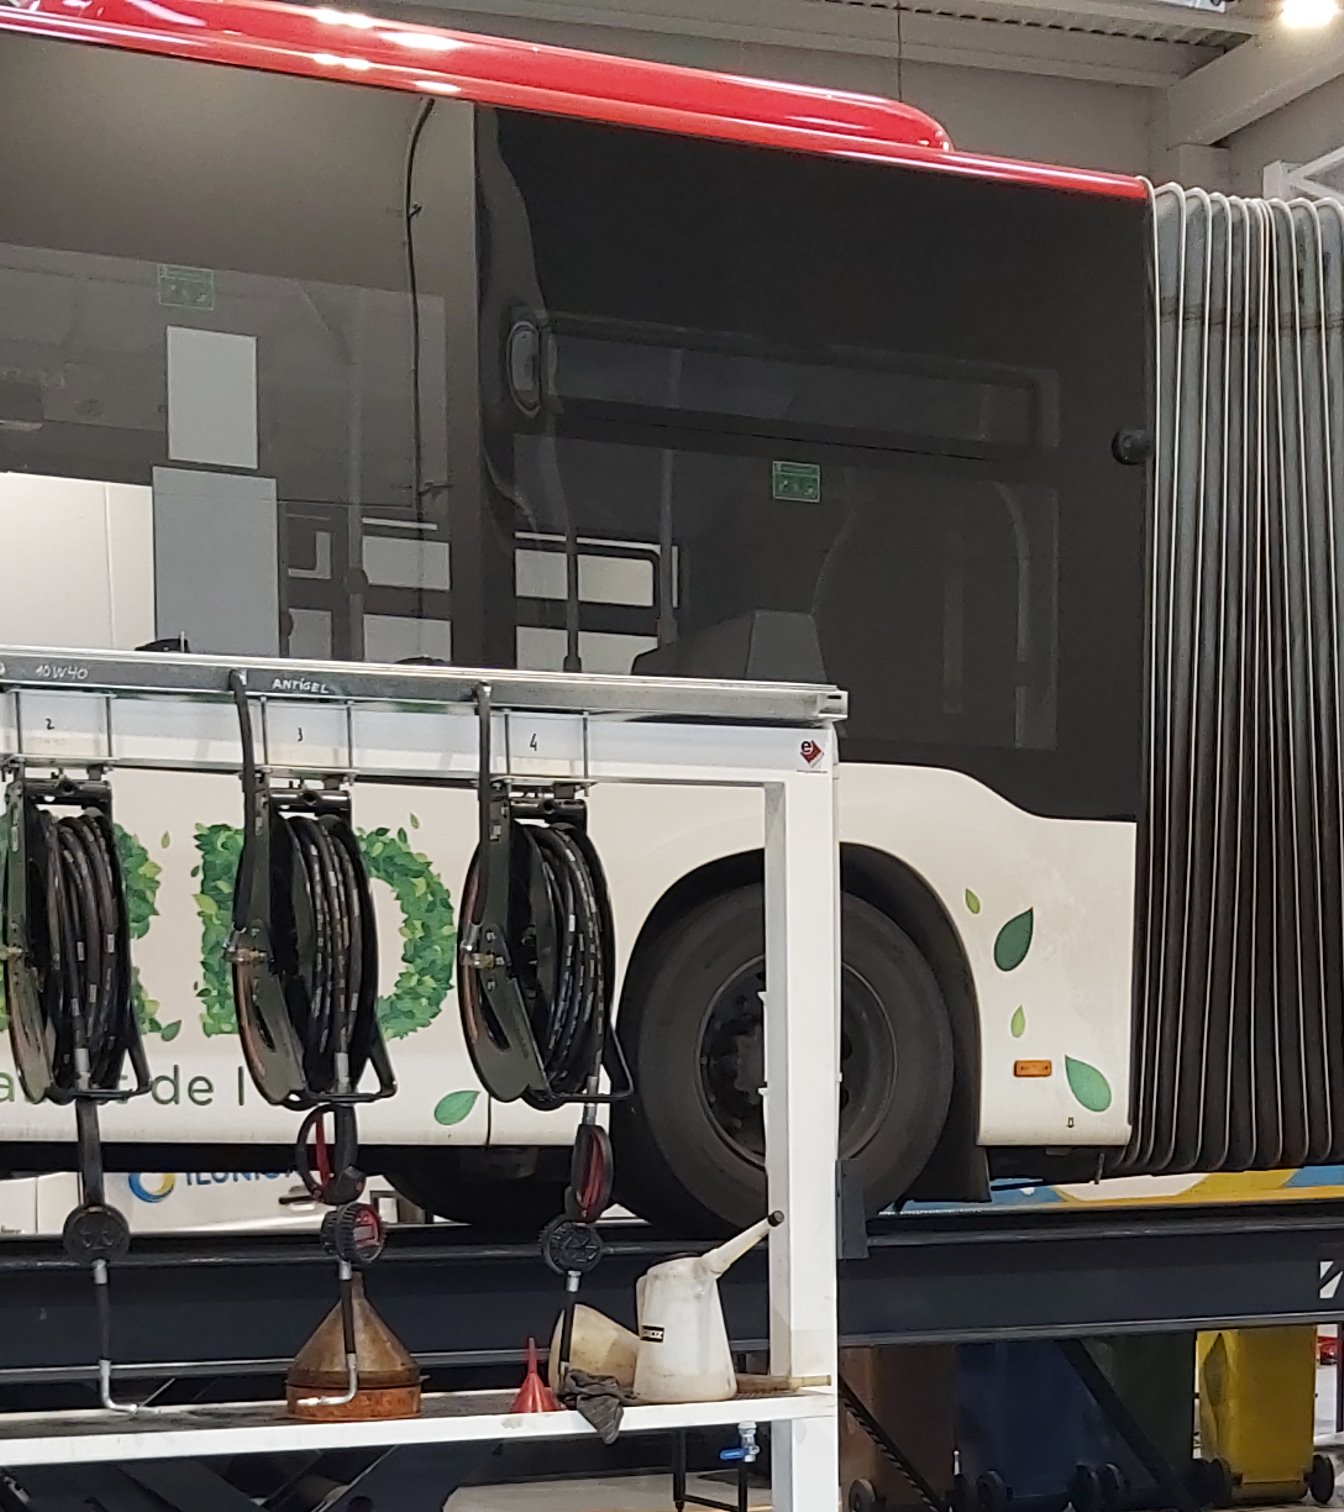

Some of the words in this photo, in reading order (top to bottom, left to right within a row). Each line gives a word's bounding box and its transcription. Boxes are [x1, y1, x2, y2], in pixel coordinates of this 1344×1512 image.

[35, 664, 89, 680] 10W40
[45, 718, 55, 731] 2
[296, 727, 305, 742] 3
[529, 732, 538, 752] 4
[150, 1064, 215, 1106] de
